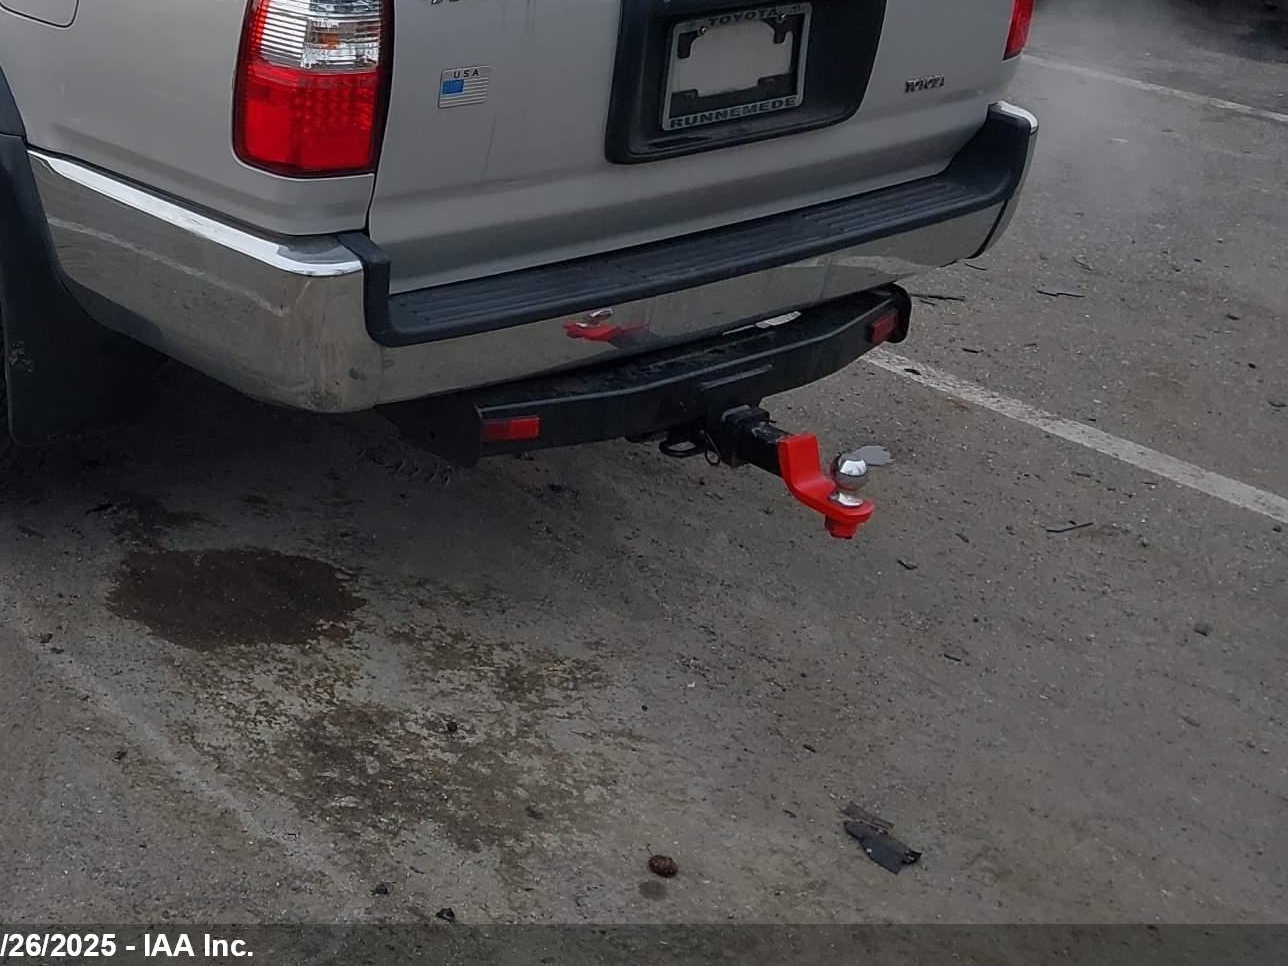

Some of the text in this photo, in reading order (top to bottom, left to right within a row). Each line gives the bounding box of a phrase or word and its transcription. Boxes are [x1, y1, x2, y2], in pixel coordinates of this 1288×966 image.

[708, 8, 778, 27] TOYOTA
[453, 68, 480, 79] USA
[670, 96, 797, 129] RUNNEMEDE
